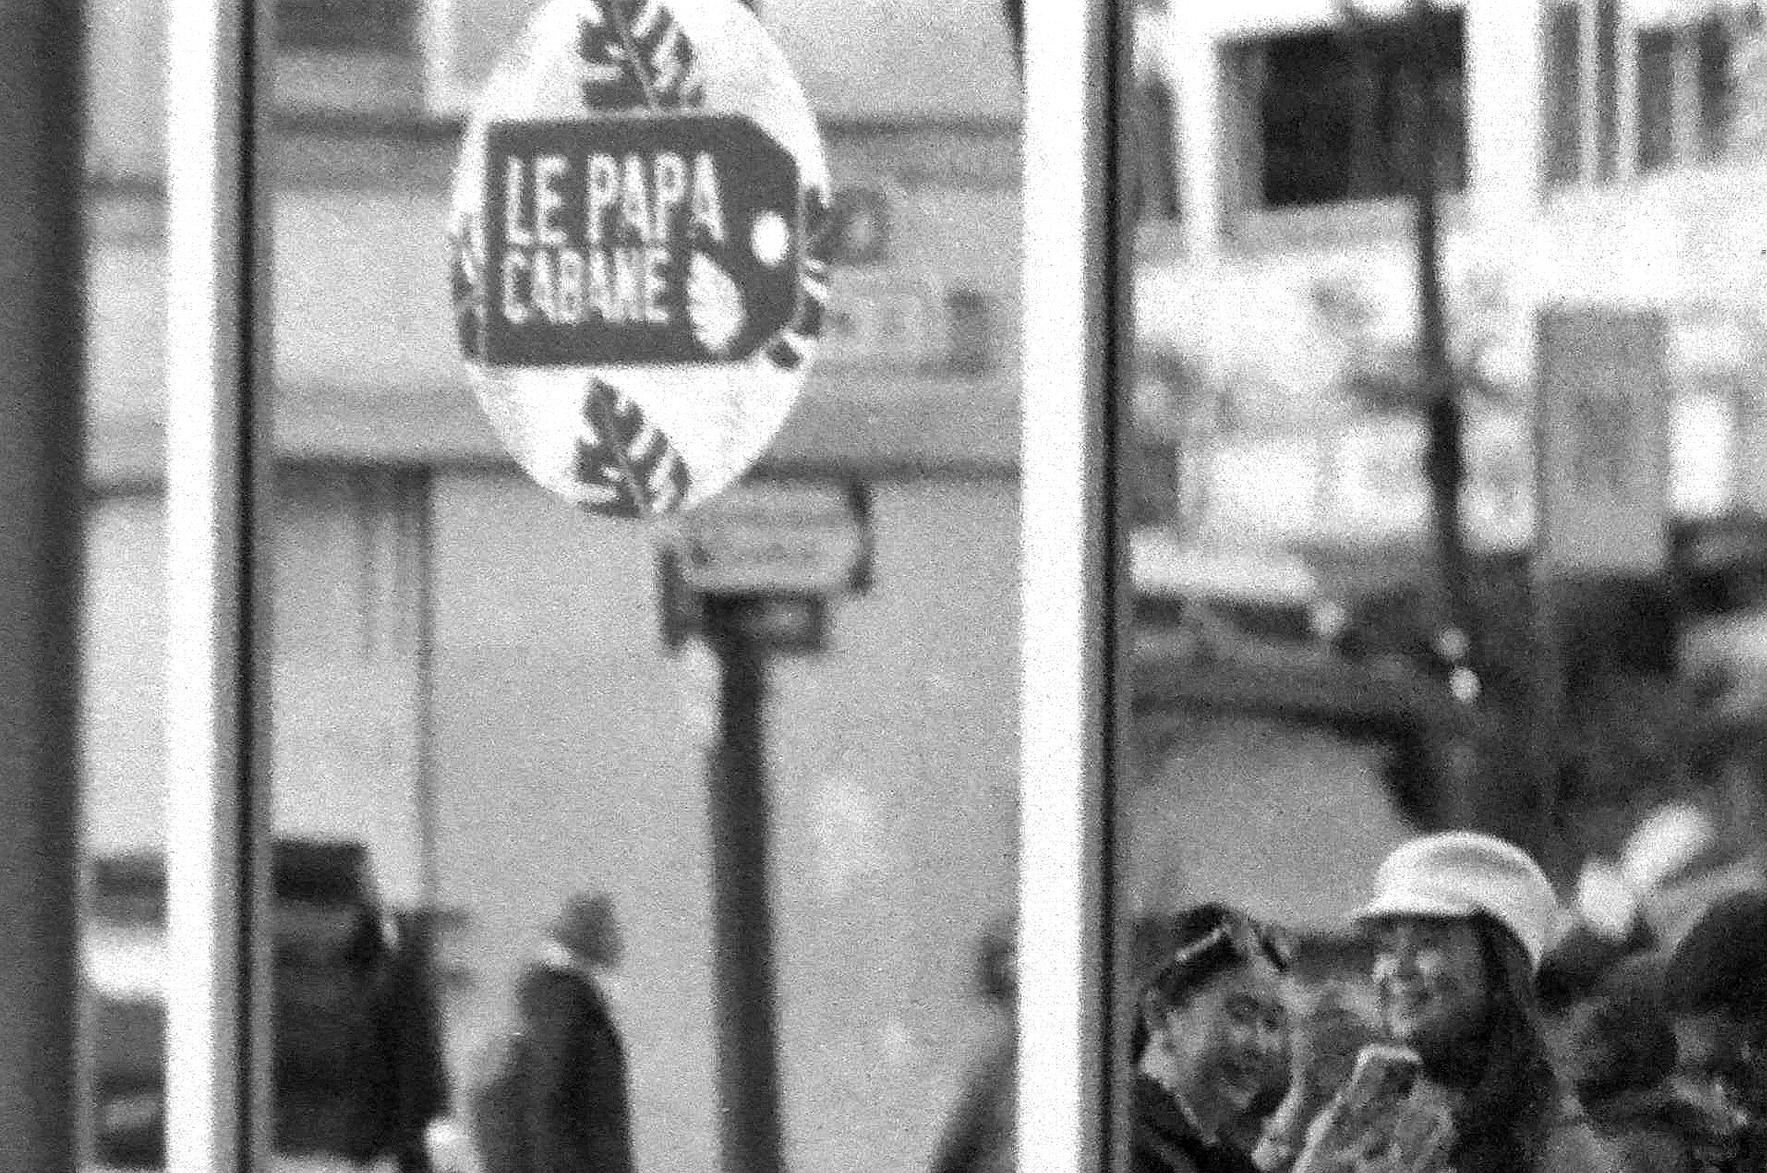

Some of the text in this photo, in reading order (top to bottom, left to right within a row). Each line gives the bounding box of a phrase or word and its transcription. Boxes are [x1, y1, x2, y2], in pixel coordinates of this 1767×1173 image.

[505, 150, 726, 245] LE PAPA
[501, 248, 672, 325] CABANE
